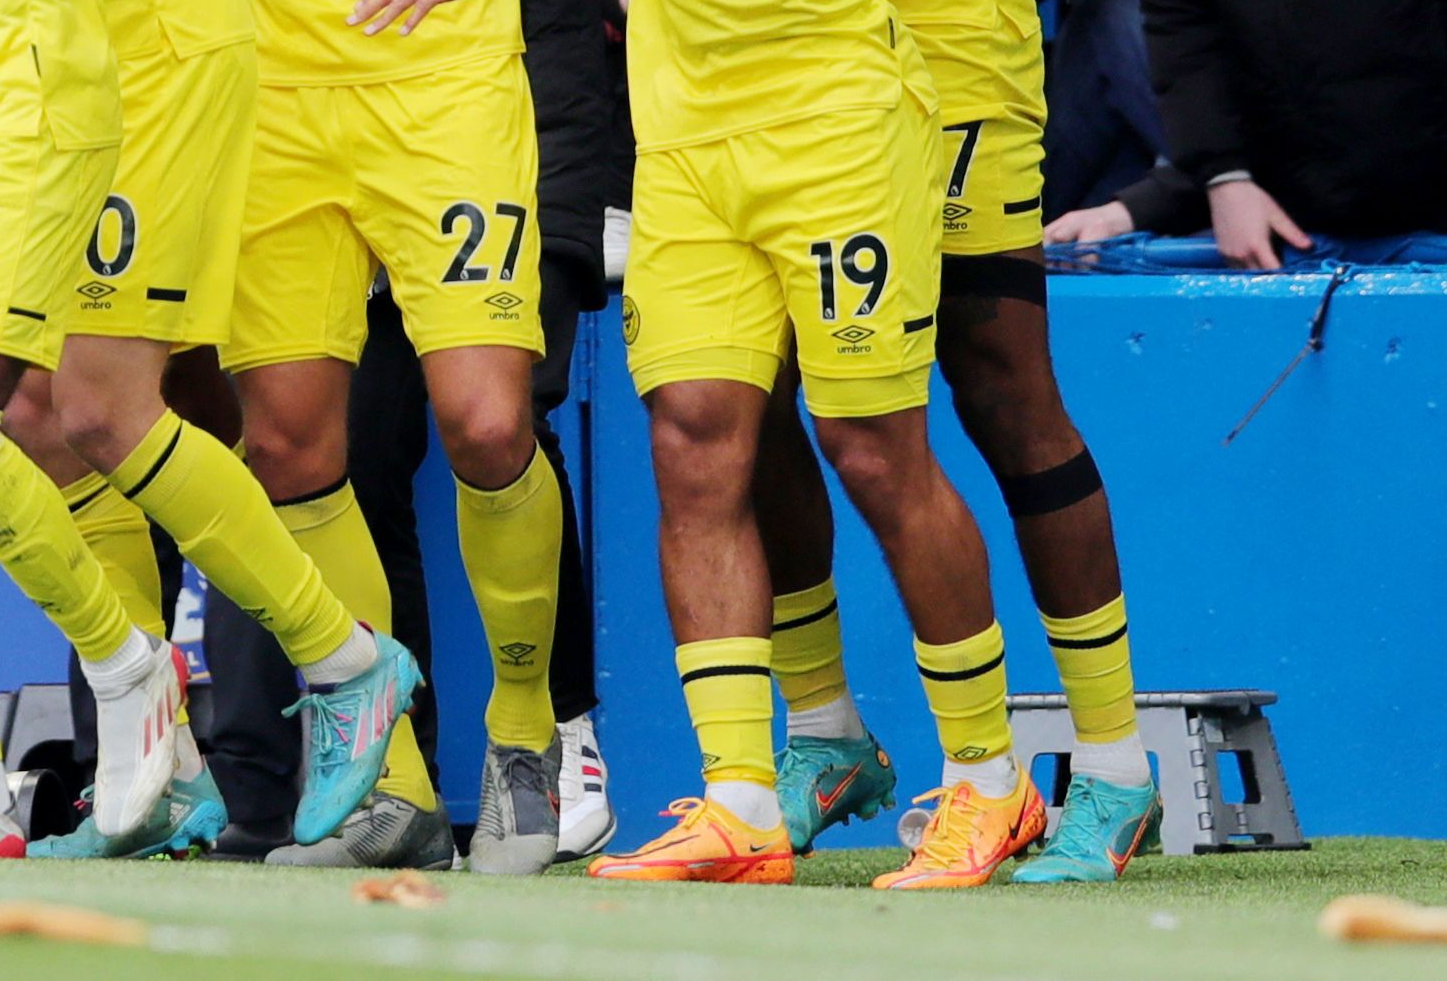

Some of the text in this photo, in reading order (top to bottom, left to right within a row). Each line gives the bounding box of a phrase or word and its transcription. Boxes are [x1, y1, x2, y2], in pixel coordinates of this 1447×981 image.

[439, 201, 527, 284] 27
[810, 232, 889, 320] 19
[80, 300, 111, 310] umbro
[489, 311, 520, 320] umbro
[837, 343, 871, 354] umbro
